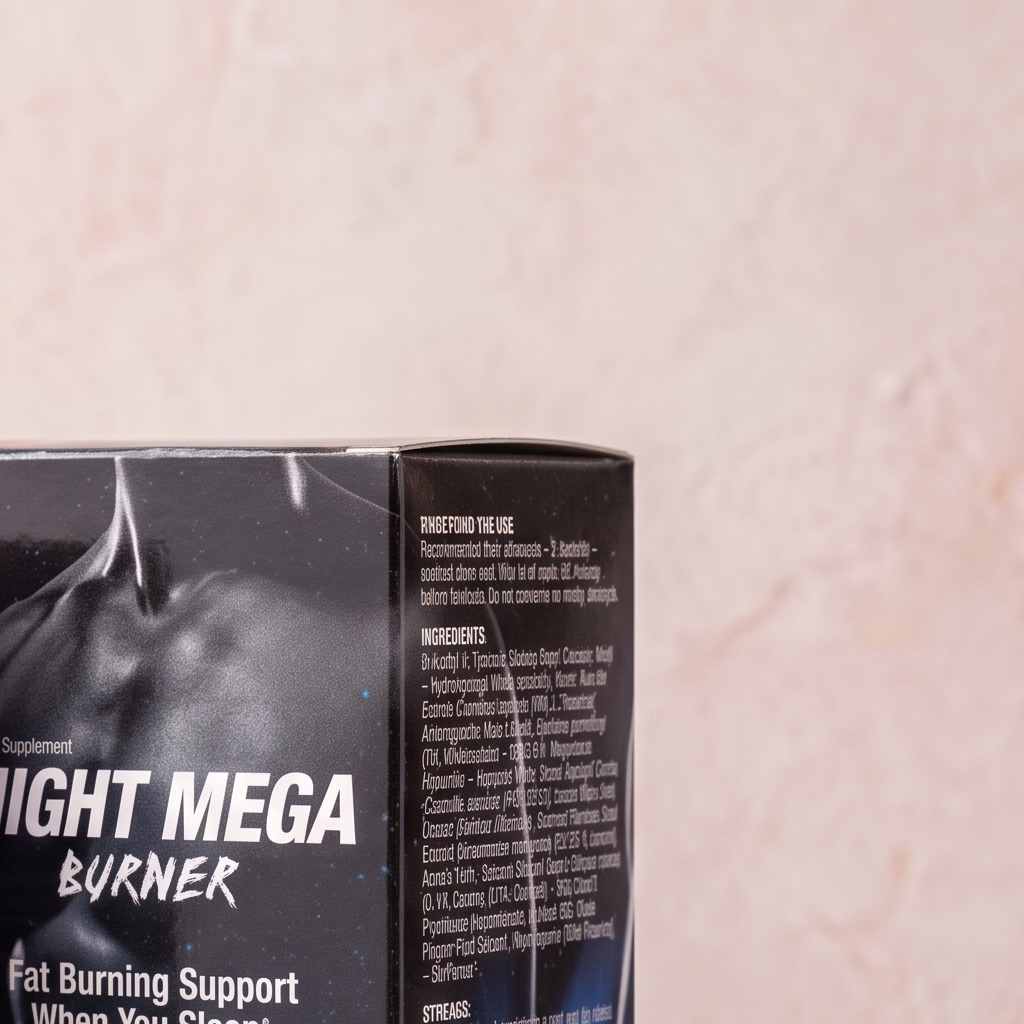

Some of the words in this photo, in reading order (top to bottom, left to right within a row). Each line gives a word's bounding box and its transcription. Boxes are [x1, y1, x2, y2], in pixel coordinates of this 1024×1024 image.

[496, 516, 514, 534] USE
[1, 737, 73, 758] Supplement
[161, 771, 357, 845] MEGA
[57, 849, 240, 909] BURNER
[9, 959, 51, 993] Fat
[59, 962, 170, 1007] Burning
[179, 967, 299, 1009] Support
